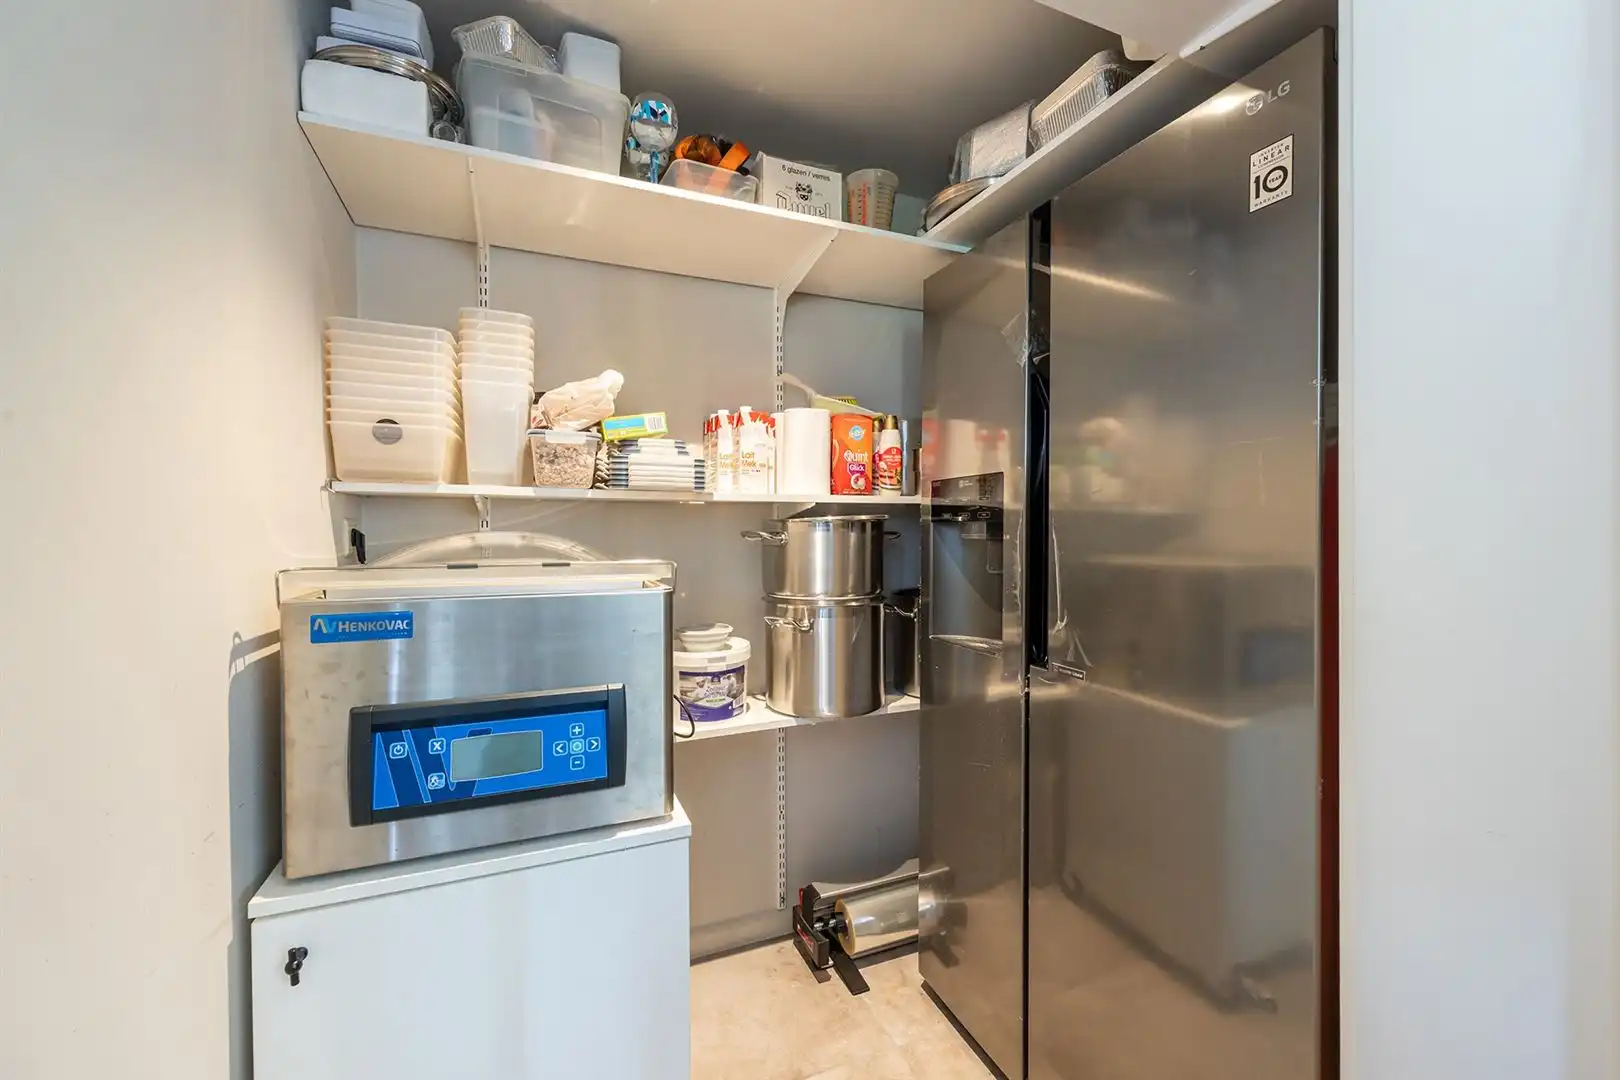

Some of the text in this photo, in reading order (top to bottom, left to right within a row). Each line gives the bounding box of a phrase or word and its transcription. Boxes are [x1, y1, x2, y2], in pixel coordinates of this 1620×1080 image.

[1268, 80, 1291, 104] LG
[1252, 144, 1290, 167] LINEAR
[787, 166, 807, 177] glazen
[812, 173, 831, 182] verres
[1269, 174, 1282, 183] YEAR
[1253, 165, 1289, 202] 10
[1254, 190, 1288, 207] WARRANTY
[338, 619, 411, 633] HENKOVAC
